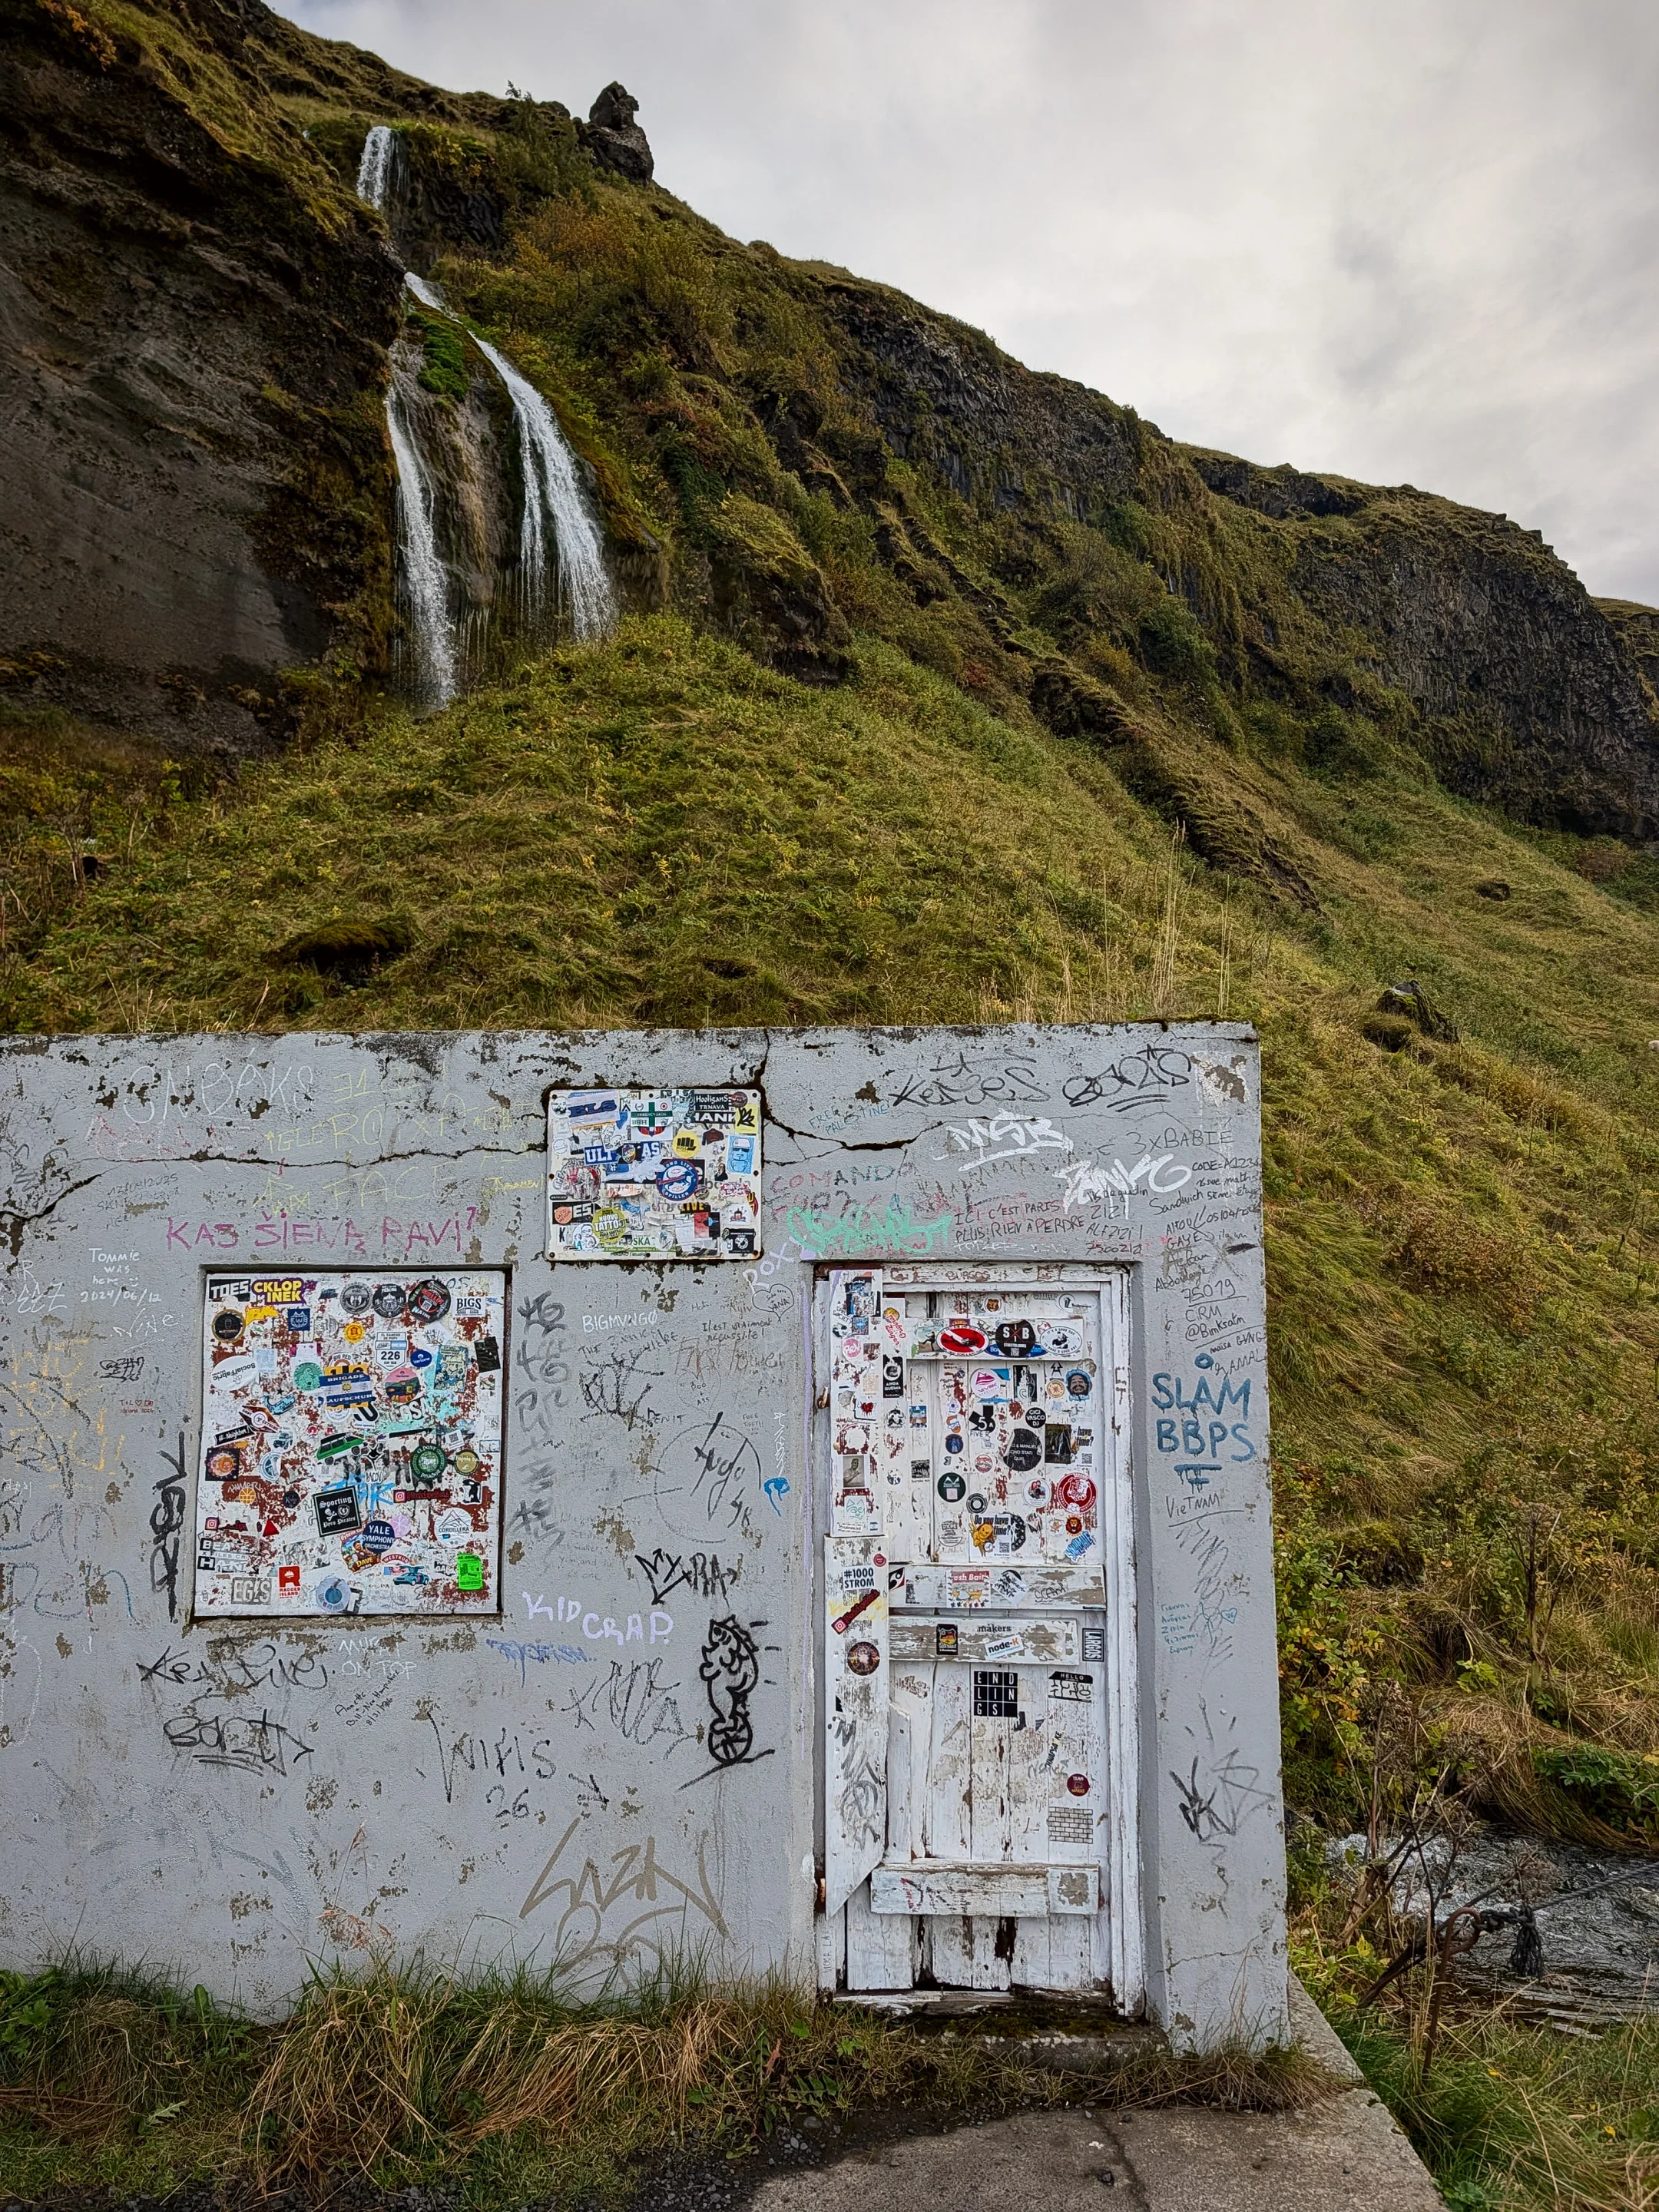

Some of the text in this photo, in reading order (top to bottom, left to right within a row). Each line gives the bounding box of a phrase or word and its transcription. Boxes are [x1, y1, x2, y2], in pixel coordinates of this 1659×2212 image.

[680, 1161, 694, 1171] LIVE
[1024, 1200, 1062, 1214] PARIS
[598, 1214, 618, 1222] NUOVO
[1035, 1215, 1085, 1235] PERDRE
[210, 1280, 250, 1300] TOES
[253, 1280, 303, 1293] CKLOP
[267, 1291, 303, 1303] INEK
[456, 1297, 482, 1310] BIGS
[886, 1314, 906, 1339] Original
[380, 1351, 401, 1361] 226
[212, 1362, 257, 1382] SocialFabric
[326, 1373, 366, 1382] BRIGADE
[1151, 1372, 1252, 1421] SLAM
[1077, 1426, 1092, 1436] have
[1076, 1436, 1094, 1447] time?
[1156, 1419, 1257, 1462] BBPS
[319, 1496, 353, 1509] Sporting
[974, 1514, 982, 1525] Do
[994, 1514, 1009, 1525] have
[369, 1525, 391, 1535] YALE
[993, 1525, 1012, 1536] time?
[362, 1535, 396, 1545] SYMPHONY
[356, 1557, 374, 1568] DAVE
[843, 1568, 874, 1579] #1000
[844, 1578, 875, 1588] STROM
[978, 1624, 1012, 1634] makers
[988, 1637, 1020, 1654] node-K
[1085, 1630, 1102, 1661] LARGOS
[1060, 1672, 1085, 1681] HELLO
